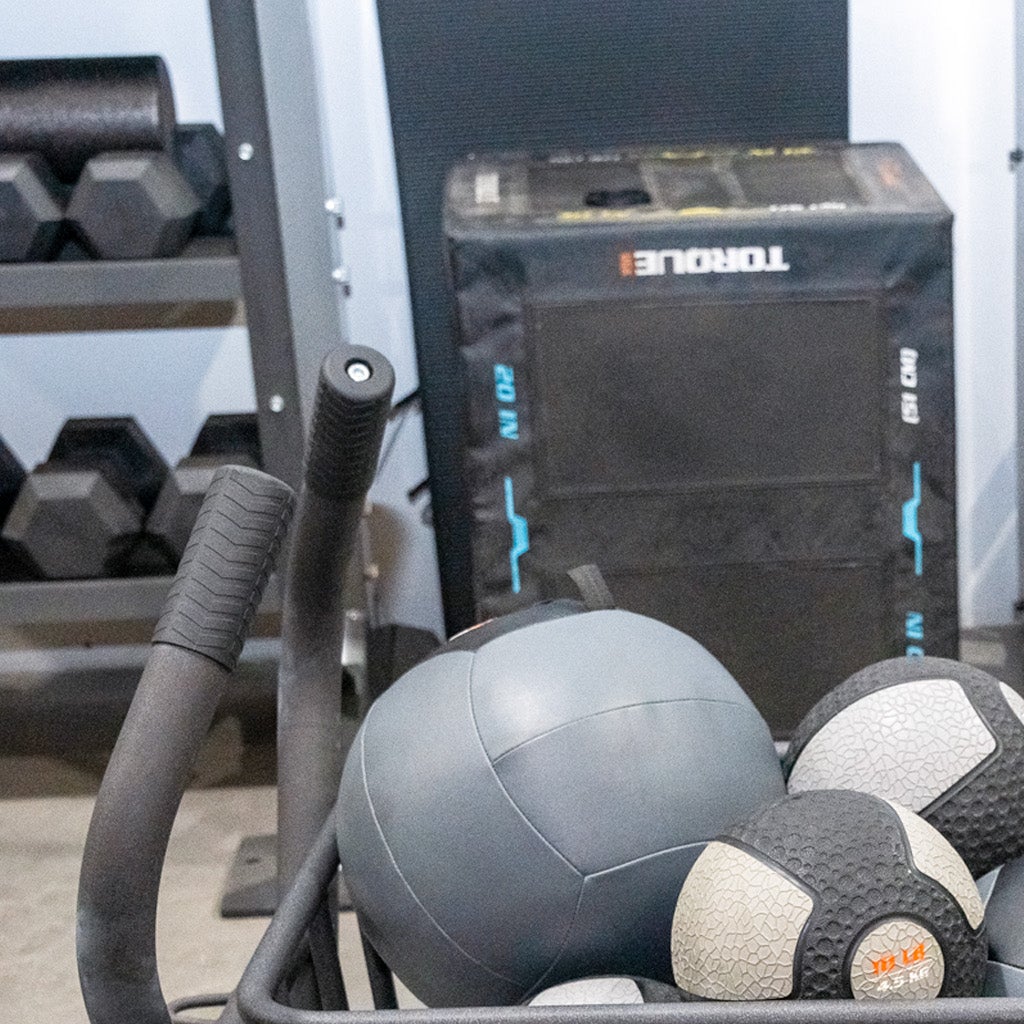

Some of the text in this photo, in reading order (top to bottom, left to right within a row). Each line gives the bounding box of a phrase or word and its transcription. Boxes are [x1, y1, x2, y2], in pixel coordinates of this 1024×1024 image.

[633, 246, 790, 276] TORQUE
[493, 363, 519, 440] 20 IN
